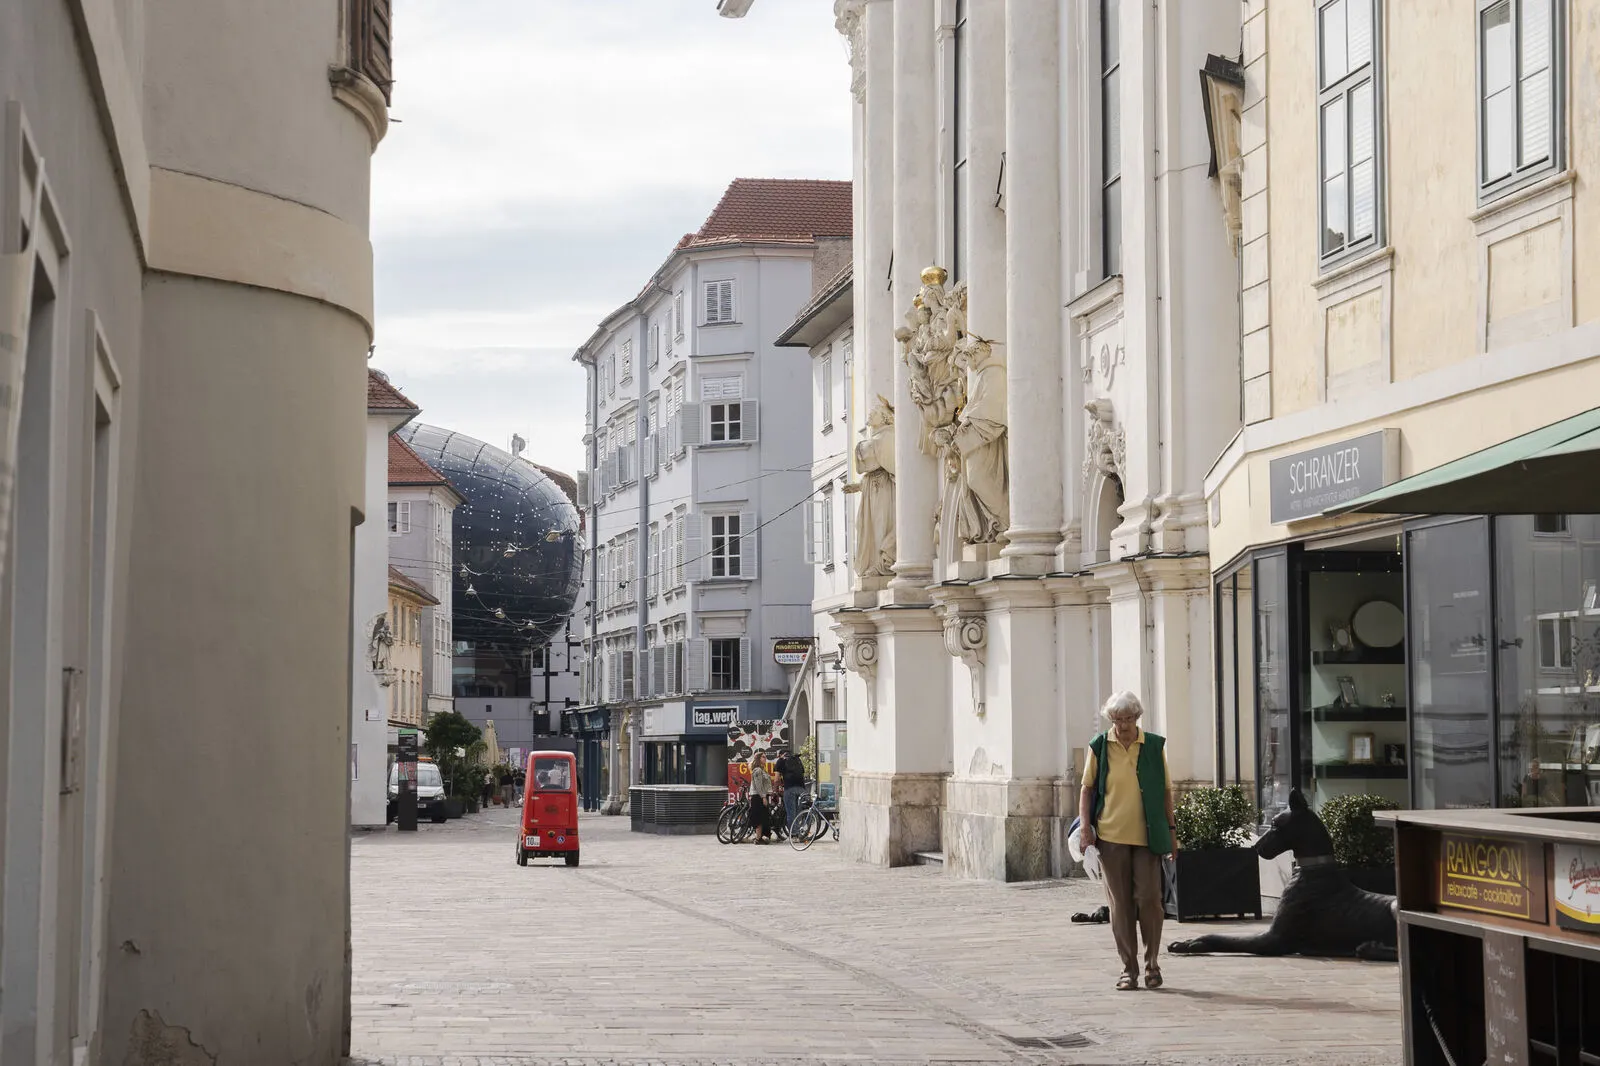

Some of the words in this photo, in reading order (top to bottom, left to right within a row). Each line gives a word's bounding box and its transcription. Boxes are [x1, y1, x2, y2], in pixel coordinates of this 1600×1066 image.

[1289, 447, 1360, 494] SCHRANZER
[695, 709, 737, 724] tag.werk
[527, 837, 534, 845] 10
[1446, 840, 1522, 882] RANGOON
